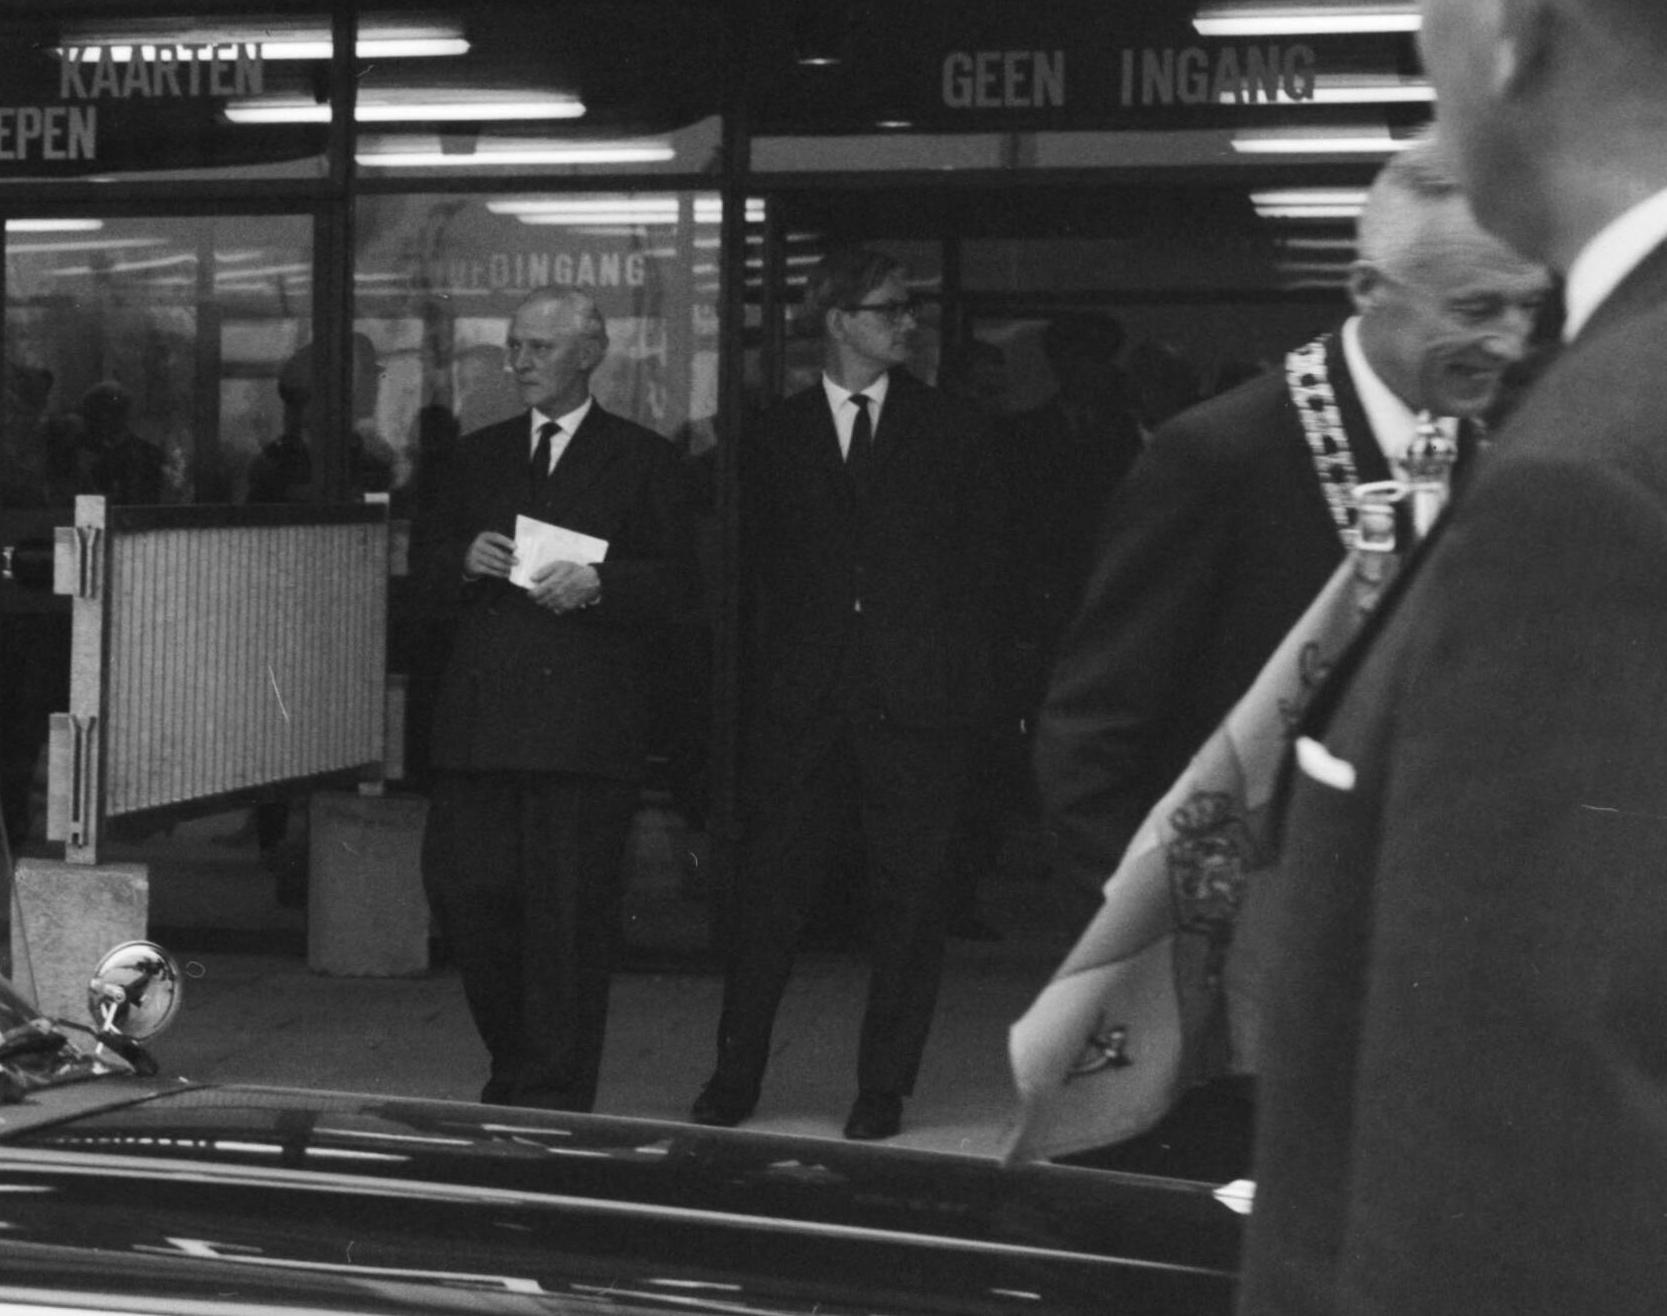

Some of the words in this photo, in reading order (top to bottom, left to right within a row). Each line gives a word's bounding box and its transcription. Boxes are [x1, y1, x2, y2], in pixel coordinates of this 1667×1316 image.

[60, 42, 264, 98] KAARTEN
[942, 49, 1065, 108] GEEN
[1121, 44, 1316, 105] INGANG
